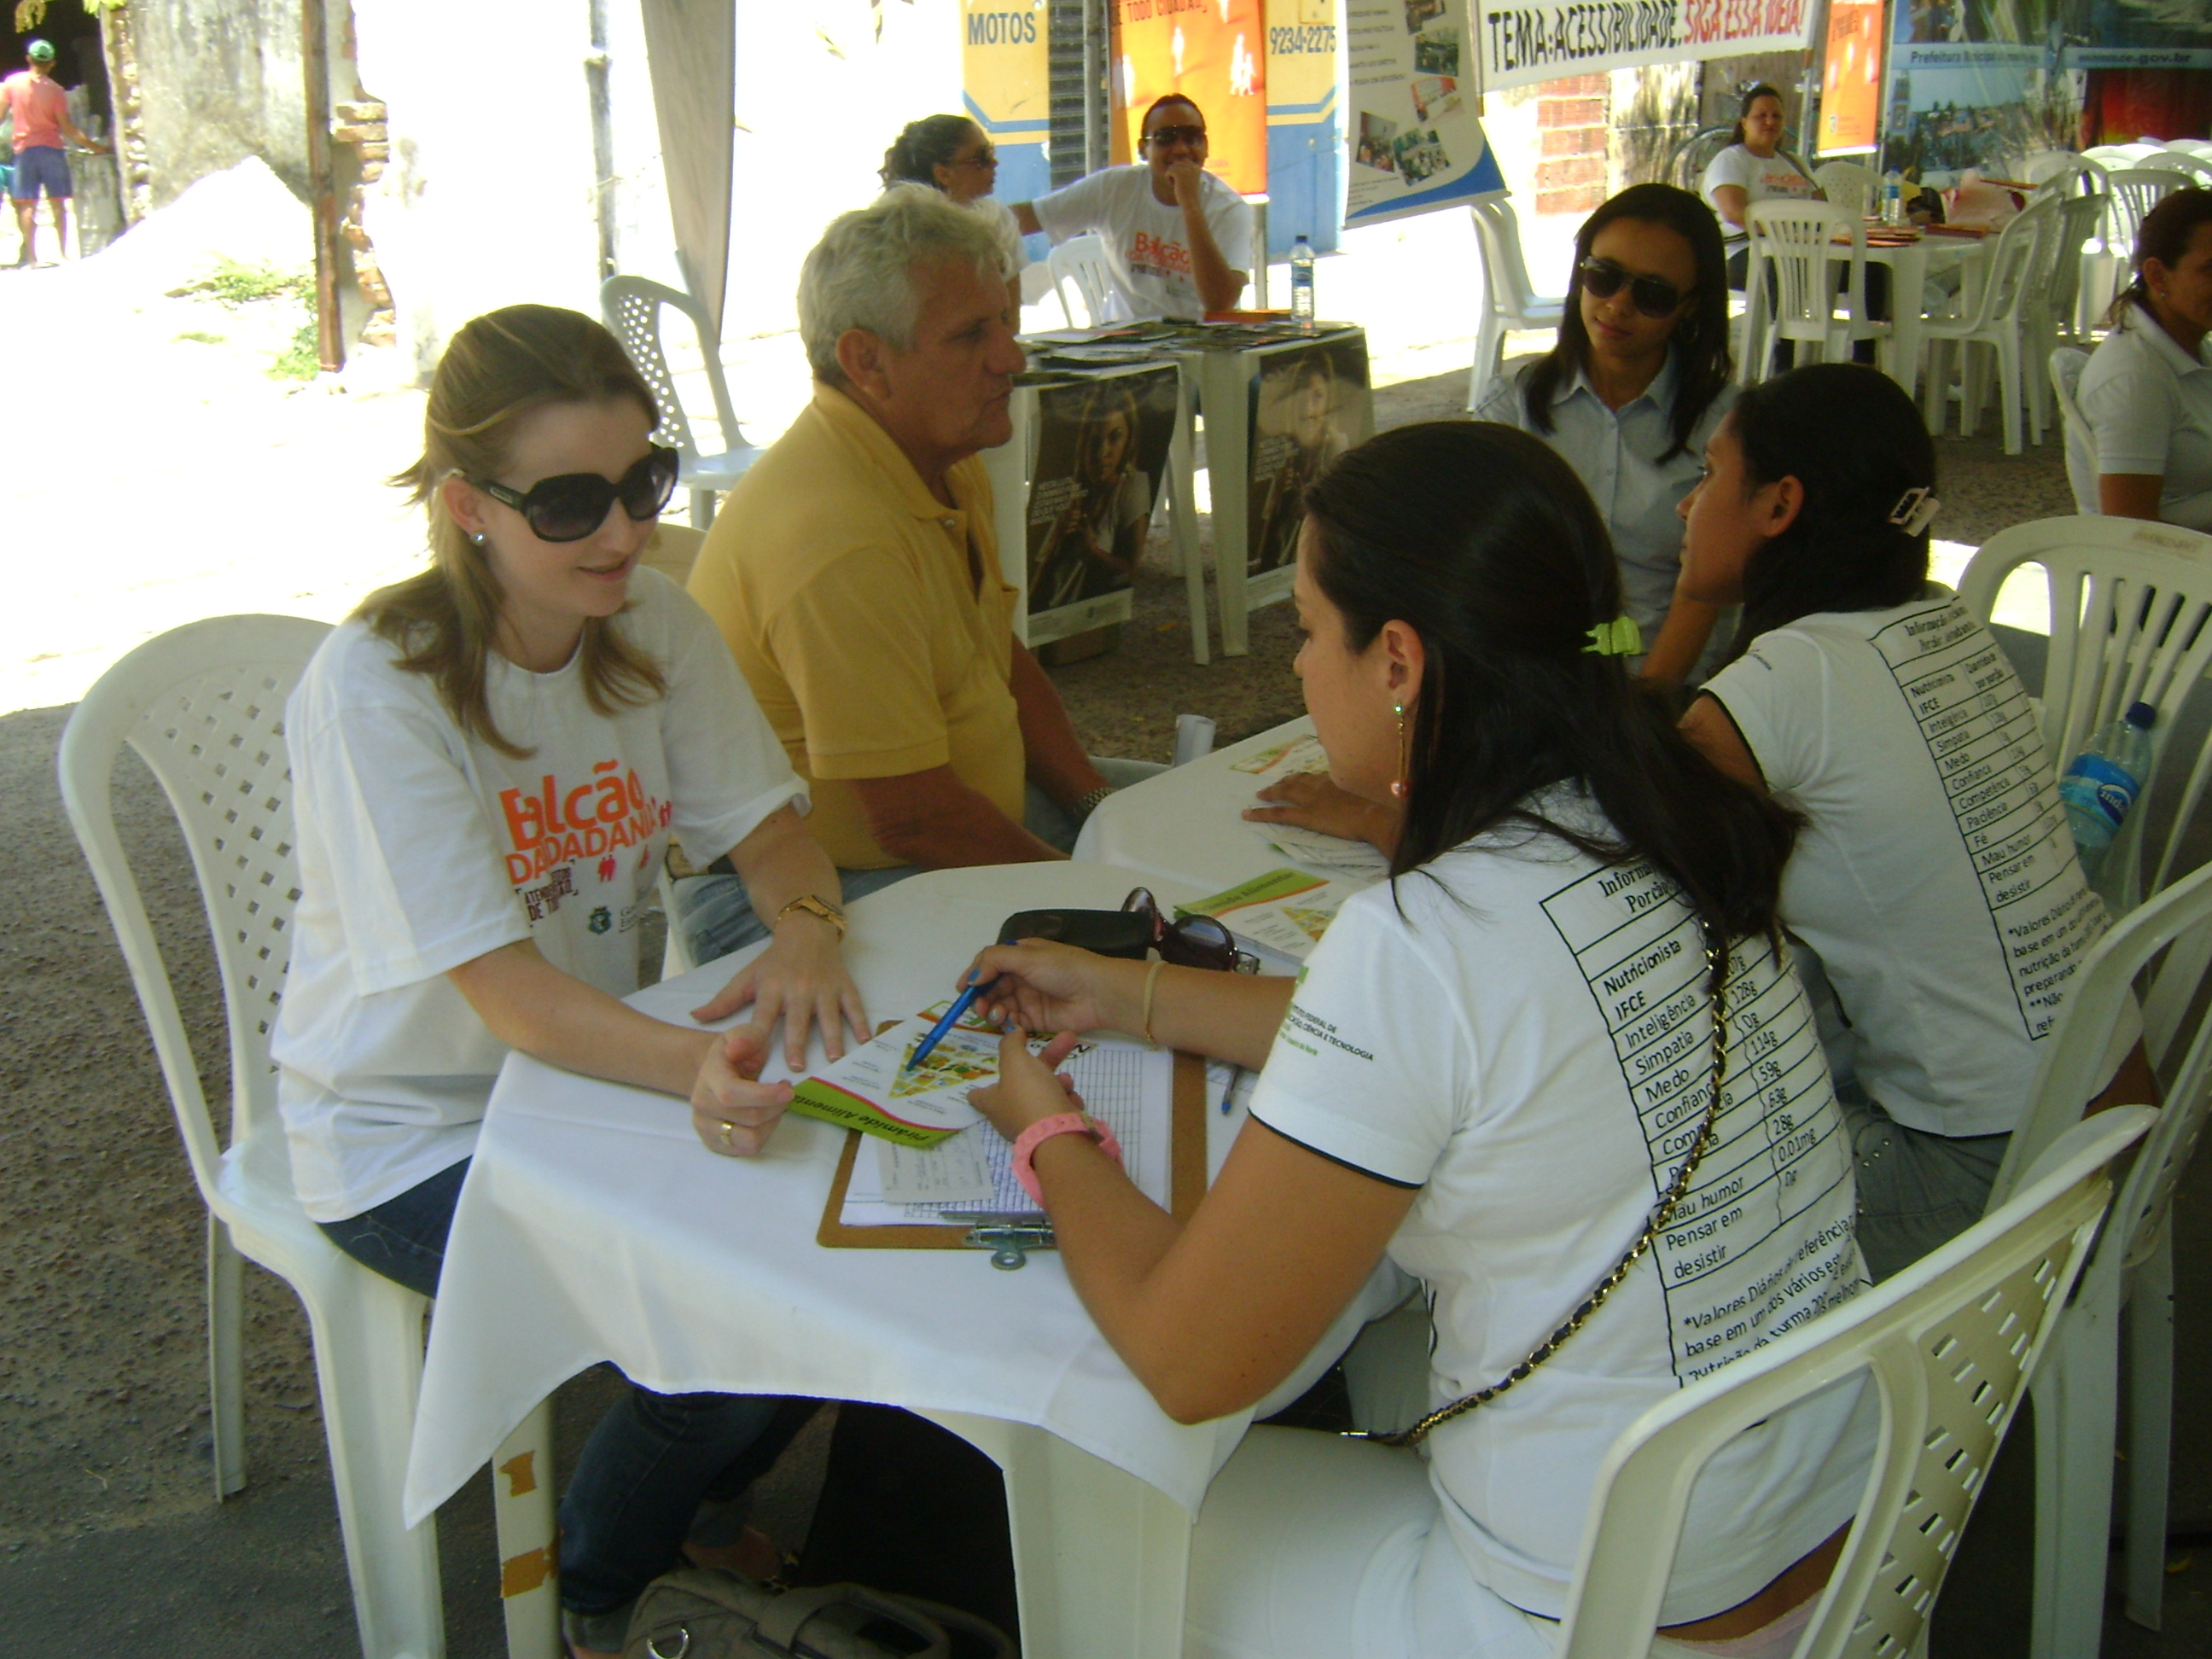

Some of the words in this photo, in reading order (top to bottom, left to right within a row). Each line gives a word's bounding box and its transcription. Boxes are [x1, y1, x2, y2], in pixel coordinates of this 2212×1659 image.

[968, 12, 1036, 45] MOTOS
[1270, 26, 1336, 55] 9234-2275
[1918, 697, 1941, 715] IFCE
[1944, 752, 1970, 771] Medo
[1973, 834, 1988, 847] Fé
[1981, 848, 2006, 867] Mau
[1988, 860, 2022, 884] Pensar
[1995, 877, 2032, 904] desistir
[2013, 938, 2040, 958] base
[2040, 931, 2055, 948] em
[1604, 940, 1682, 997] Nutricionista
[2018, 951, 2061, 978] nutrição
[1615, 991, 1647, 1022] IFCE
[1625, 995, 1697, 1049] Inteligência
[1635, 1031, 1695, 1076] Simpatia
[1731, 979, 1758, 1006] 128g
[1329, 1035, 1374, 1062] TECNOLOGIA
[1645, 1069, 1690, 1103] Medo
[1743, 1010, 1761, 1030] 0g
[1750, 1029, 1778, 1057] 114g
[1760, 1059, 1783, 1083] 59g
[1768, 1086, 1789, 1109] 63g
[859, 1115, 931, 1142] Pirâmide
[1773, 1113, 1795, 1136] 28g
[1701, 1177, 1743, 1209] humor
[1666, 1220, 1718, 1251] Pensar
[1720, 1208, 1743, 1227] em
[1674, 1245, 1726, 1279] desistir
[1685, 1333, 1722, 1358] base
[1726, 1321, 1748, 1342] em
[1784, 1266, 1826, 1298] vários
[1769, 1307, 1812, 1337] turma
